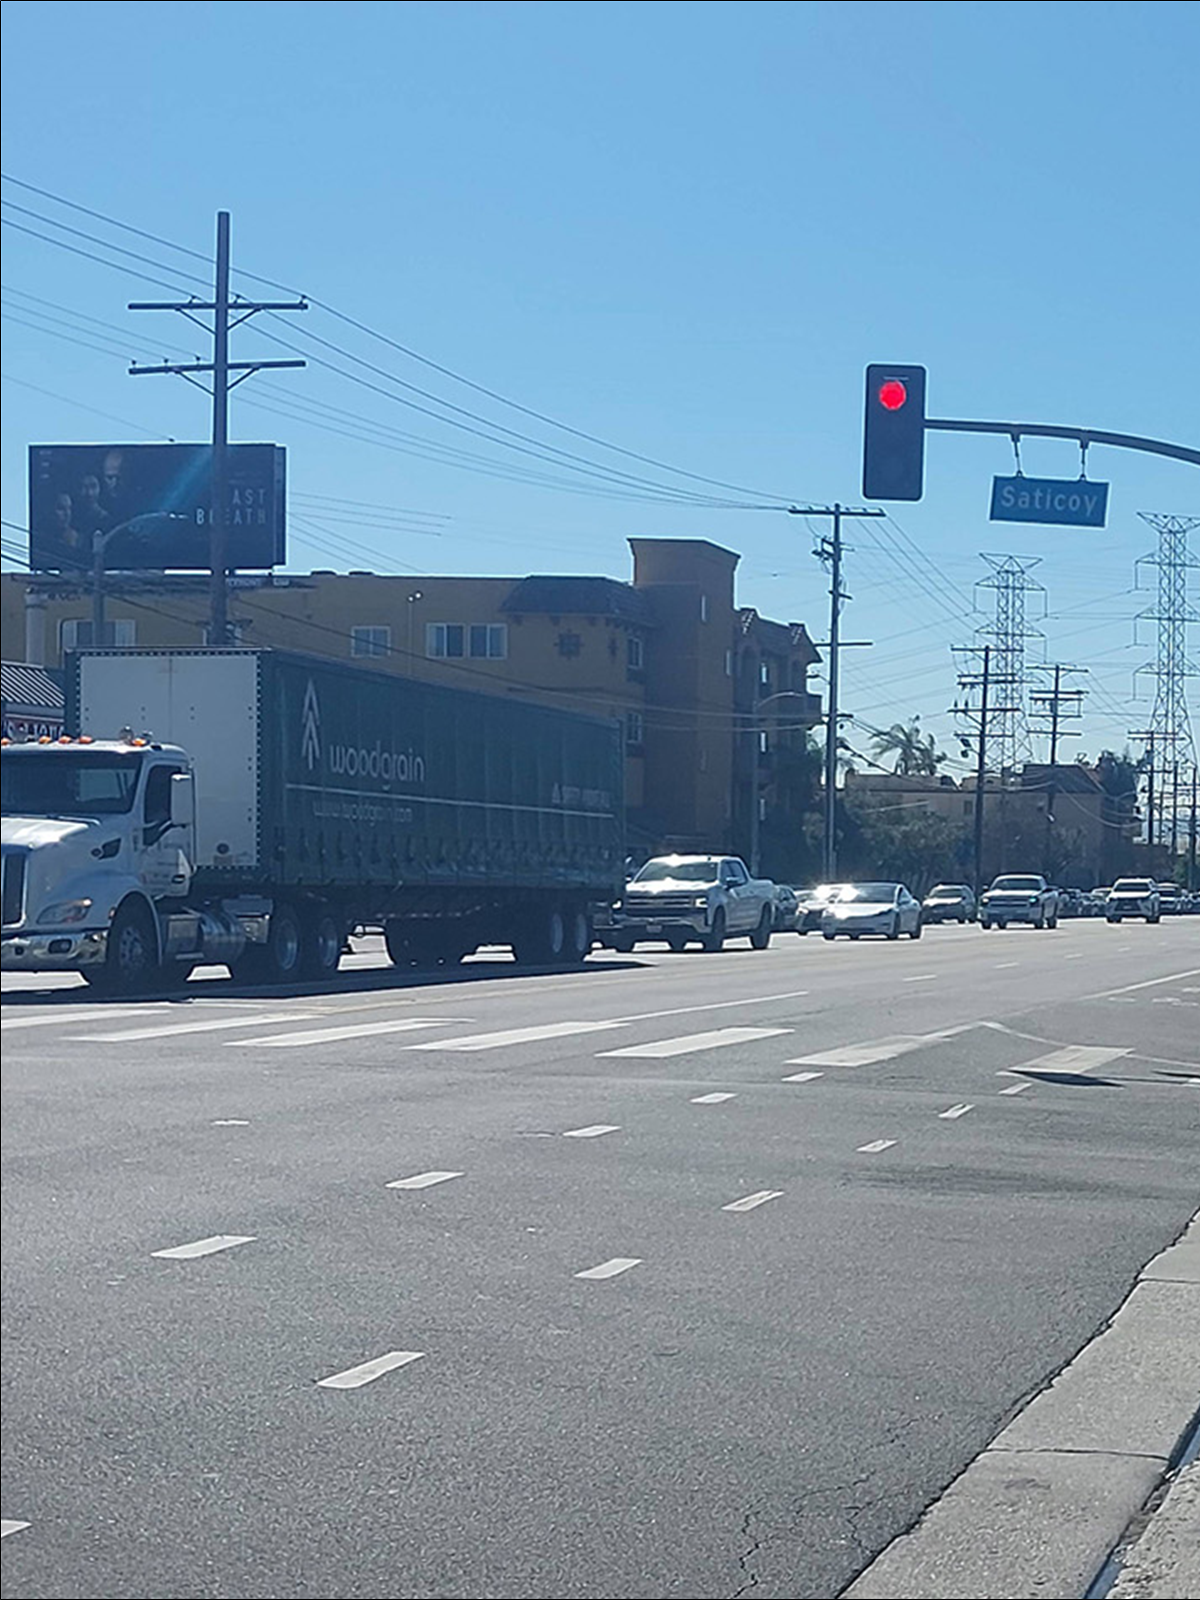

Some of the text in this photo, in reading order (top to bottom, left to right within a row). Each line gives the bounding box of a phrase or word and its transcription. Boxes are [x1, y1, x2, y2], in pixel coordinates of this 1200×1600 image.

[196, 508, 266, 525] BATH
[1001, 485, 1098, 517] Saticoy
[330, 740, 425, 791] woodgrain
